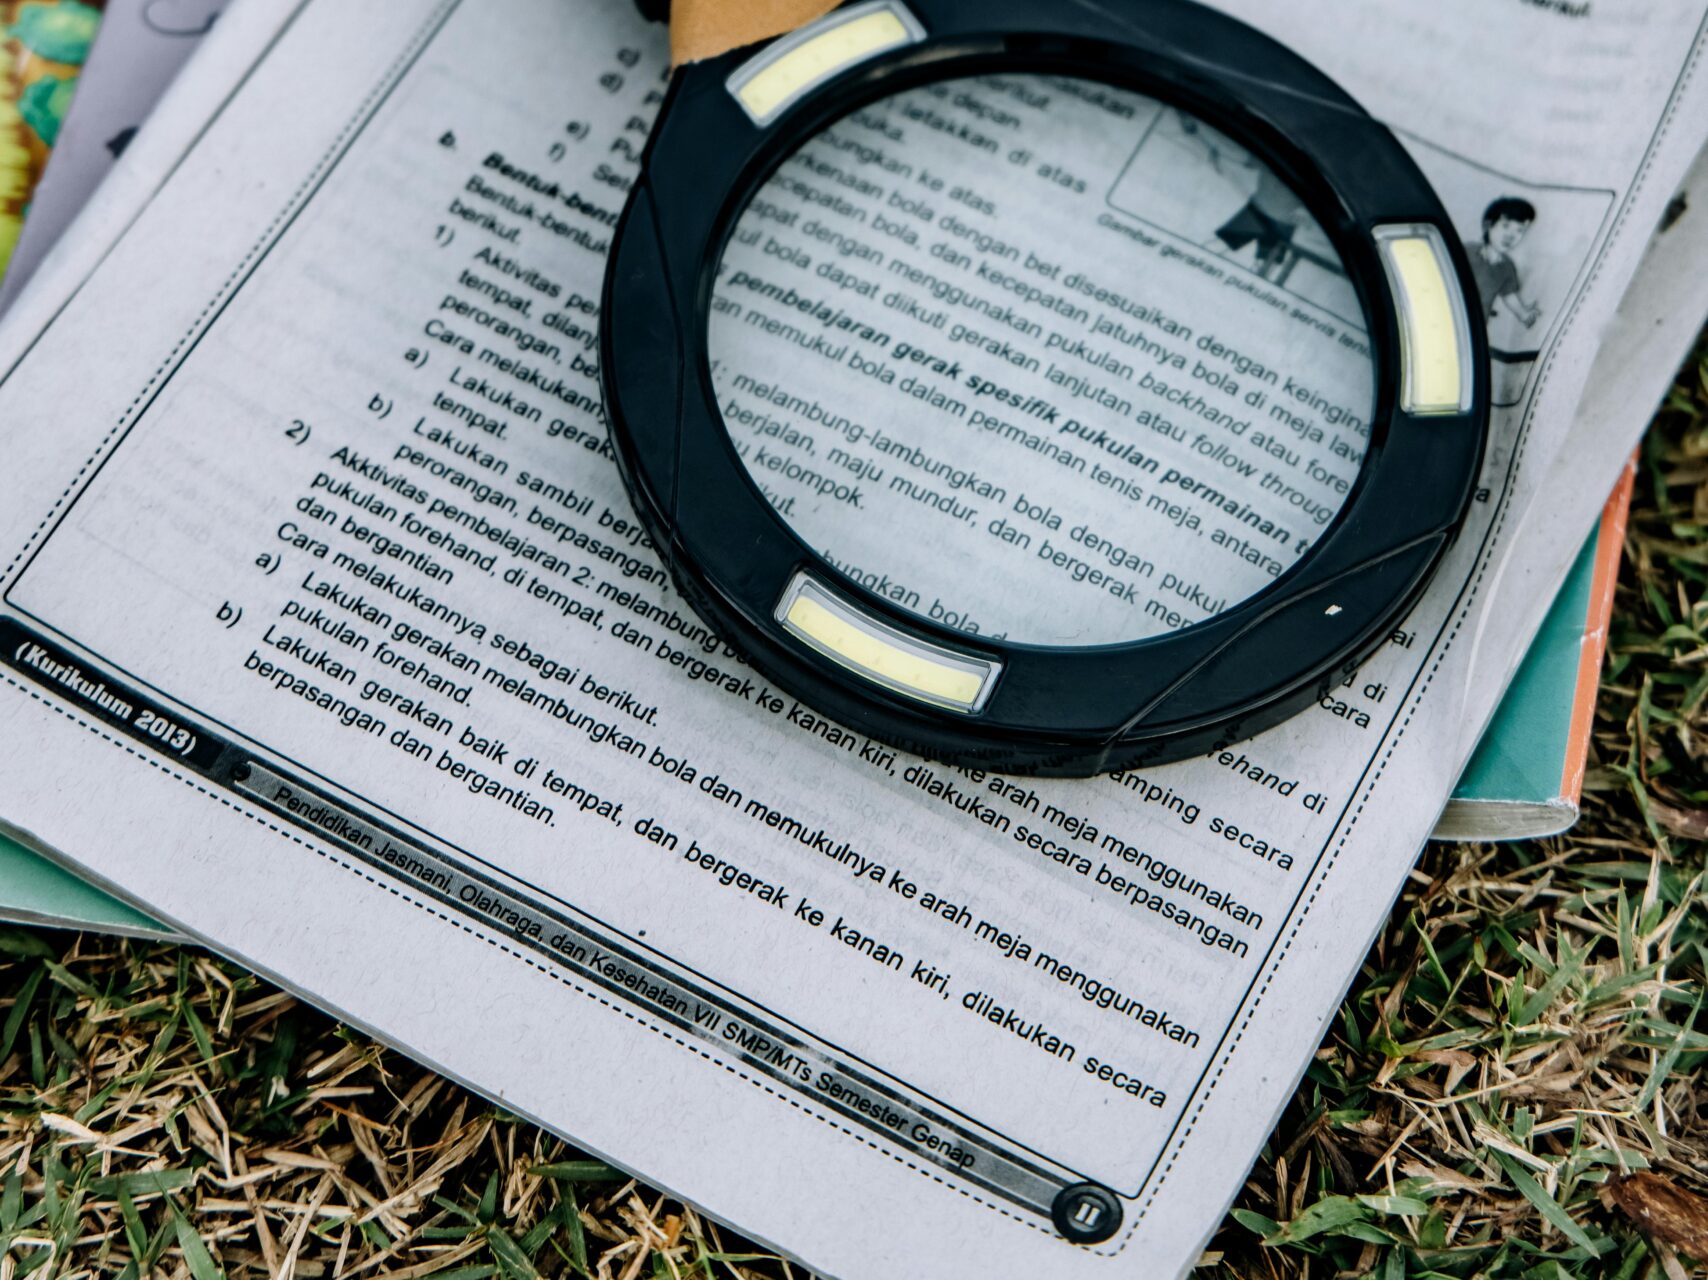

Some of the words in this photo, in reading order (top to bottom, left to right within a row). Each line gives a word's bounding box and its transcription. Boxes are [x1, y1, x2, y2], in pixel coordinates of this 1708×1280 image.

[424, 319, 475, 355] Cara
[435, 224, 455, 248] 1)
[474, 246, 562, 299] Aktivitas
[439, 295, 562, 365] perorangan,
[458, 269, 532, 319] tempat,
[870, 212, 920, 250] bola,
[929, 243, 972, 270] dan
[975, 261, 1089, 324] kecepatan
[1088, 314, 1188, 371] jatuhnya
[1191, 360, 1240, 397] bola
[1244, 391, 1268, 410] di
[1269, 405, 1325, 445] meja
[887, 189, 935, 223] bola
[938, 216, 1020, 262] dengan
[1023, 252, 1062, 281] bet
[1063, 274, 1193, 342] disesuaikan
[1196, 335, 1279, 386] dengan
[404, 348, 429, 369] a)
[449, 367, 543, 423] Lakukan
[432, 392, 508, 440] tempat.
[724, 270, 891, 347] pembelajaran
[891, 343, 962, 381] gerak
[965, 375, 1060, 425] spesifik
[1058, 419, 1159, 474] pukulan
[1159, 469, 1291, 545] permainan
[761, 235, 812, 270] bola
[815, 262, 881, 300] dapat
[882, 292, 948, 330] diikuti
[948, 324, 1040, 373] gerakan
[1044, 363, 1132, 417] lanjutan
[1135, 410, 1187, 443] atau
[1190, 433, 1259, 478] follow
[800, 219, 884, 265] dengan
[887, 259, 1043, 339] menggunakan
[1044, 332, 1134, 381] pukulan
[1137, 371, 1252, 437] backhand
[1249, 431, 1301, 468] atau
[367, 393, 393, 420] b)
[413, 417, 509, 476] Lakukan
[516, 471, 595, 517] sambil
[393, 444, 518, 518] perorangan,
[524, 501, 673, 595] berpasangan,
[721, 396, 819, 459] berjalan,
[826, 448, 884, 483] maju
[888, 476, 978, 528] mundur,
[987, 518, 1031, 550] dan
[1037, 539, 1139, 605] bergerak
[730, 373, 1007, 504] melambung-lambungkan
[1012, 493, 1063, 531] bola
[1069, 525, 1155, 578] dengan
[743, 309, 848, 362] memukul
[847, 351, 896, 386] bola
[898, 377, 967, 418] dalam
[967, 409, 1087, 473] permainan
[1089, 463, 1144, 501] tenis
[1145, 494, 1204, 537] meja,
[1208, 526, 1285, 578] antara
[753, 446, 864, 510] kelompok.
[284, 419, 311, 446] 2)
[329, 446, 429, 505] Akktivitas
[426, 498, 571, 577] pembelajaran
[571, 566, 595, 589] 2:
[594, 578, 723, 654] melambung
[296, 496, 338, 526] dan
[340, 515, 454, 585] bergantian
[15, 641, 134, 720] (Kurikulum
[133, 709, 197, 756] 2013)
[277, 521, 330, 560] Cara
[331, 552, 487, 645] melakukannya
[489, 633, 581, 686] sebagai
[579, 674, 658, 728] berikut.
[279, 600, 370, 653] pukulan
[372, 641, 473, 708] forehand.
[1363, 683, 1388, 703] di
[243, 649, 387, 737] berpasangan
[389, 729, 433, 762] dan
[435, 749, 555, 828] bergantian.
[309, 472, 398, 523] pukulan
[399, 512, 498, 577] forehand,
[503, 567, 528, 588] di
[526, 576, 604, 632] tempat,
[610, 621, 654, 652] dan
[655, 639, 756, 701] bergerak
[755, 687, 785, 714] ke
[784, 700, 859, 753] kanan
[858, 734, 898, 777] kiri,
[903, 765, 1011, 833] dilakukan
[1013, 825, 1093, 877] secara
[1094, 862, 1249, 959] berpasangan
[215, 600, 243, 630] b)
[262, 624, 357, 686] Lakukan
[359, 680, 454, 736] gerakan
[458, 725, 509, 766] baik
[513, 757, 540, 779] di
[541, 769, 624, 828] tempat,
[633, 817, 679, 851] dan
[683, 840, 790, 910] bergerak
[793, 897, 825, 927] ke
[829, 916, 904, 971] kanan
[910, 959, 951, 1001] kiri,
[961, 991, 1076, 1063] dilakukan
[1083, 1056, 1167, 1109] secara
[255, 553, 282, 576] a)
[300, 570, 393, 630] Lakukan
[390, 622, 481, 676] gerakan
[481, 667, 647, 759] melambungkan
[647, 745, 698, 785] bola
[699, 774, 743, 809] dan
[743, 799, 887, 884] memukulnya
[887, 869, 918, 900] ke
[919, 892, 973, 929] arah
[974, 920, 1032, 962] meja
[1033, 952, 1200, 1049] menggunakan
[987, 777, 1041, 814] arah
[1041, 804, 1099, 844] meja
[1100, 834, 1263, 931] menggunakan
[1209, 817, 1294, 872] secara
[1302, 793, 1328, 815] di
[271, 784, 375, 851] Pendidikan
[372, 838, 453, 897] Jasmani,
[456, 883, 546, 945] Olahraga,
[549, 932, 589, 964] dan
[587, 949, 690, 1018] Kesehatan
[689, 1002, 723, 1033] VII
[719, 1019, 815, 1083] SMP/MTs
[814, 1073, 910, 1134] Semester
[908, 1122, 978, 1173] Genap
